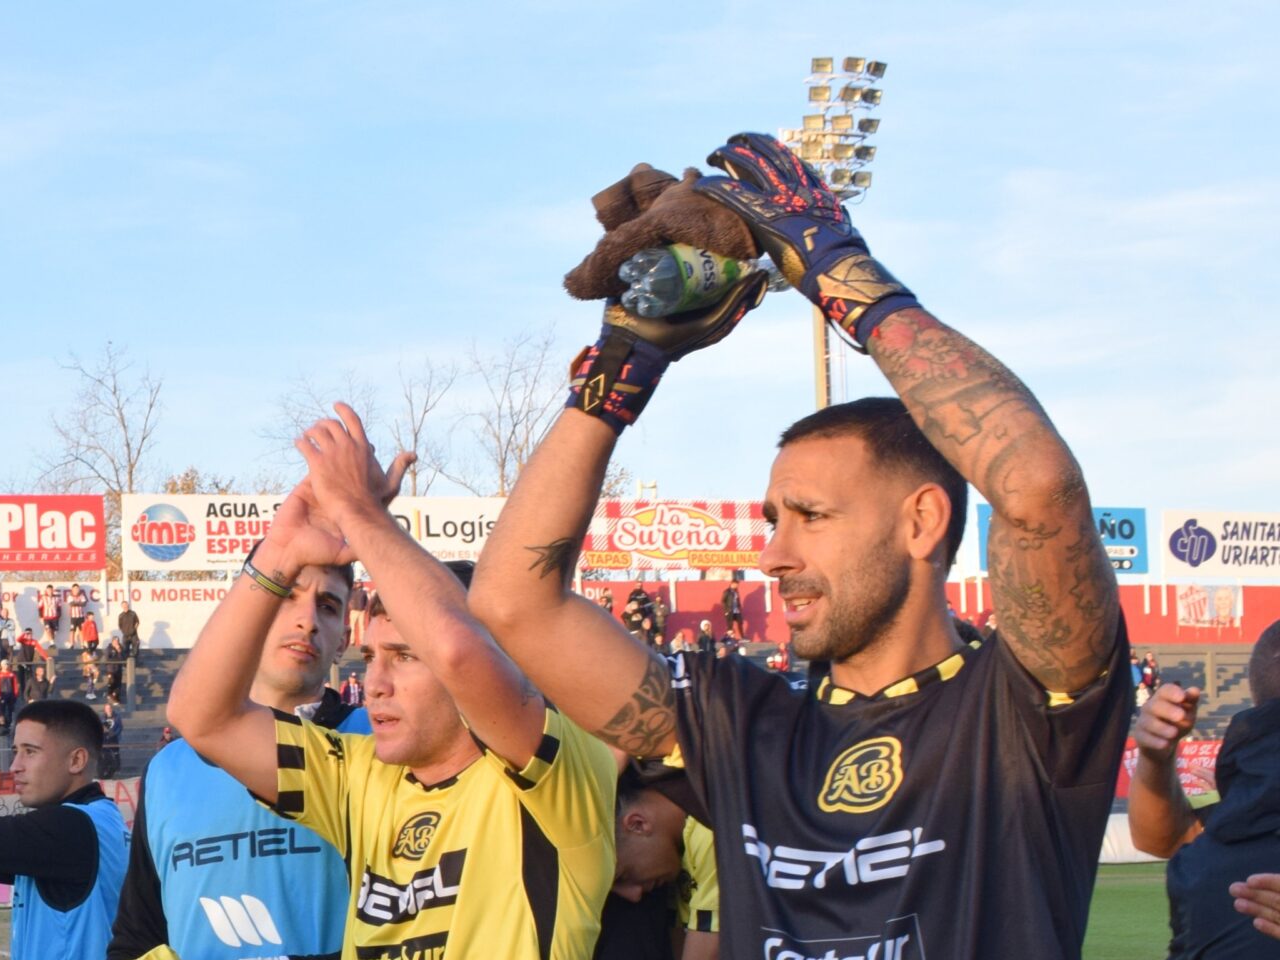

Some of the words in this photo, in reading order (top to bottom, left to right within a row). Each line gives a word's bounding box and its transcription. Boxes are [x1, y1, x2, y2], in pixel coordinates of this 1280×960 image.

[698, 248, 716, 292] vess
[206, 503, 260, 518] AGUA
[658, 507, 681, 526] La
[206, 520, 230, 536] LA
[235, 520, 272, 536] BUE
[425, 512, 499, 544] Logís
[620, 520, 726, 550] Sureña
[1100, 512, 1135, 540] ÑO
[1221, 520, 1280, 542] SANITA
[207, 538, 259, 554] ESPE
[2, 553, 97, 561] HERRAJES
[588, 552, 630, 565] TAPAS
[171, 828, 322, 872] RETIEL
